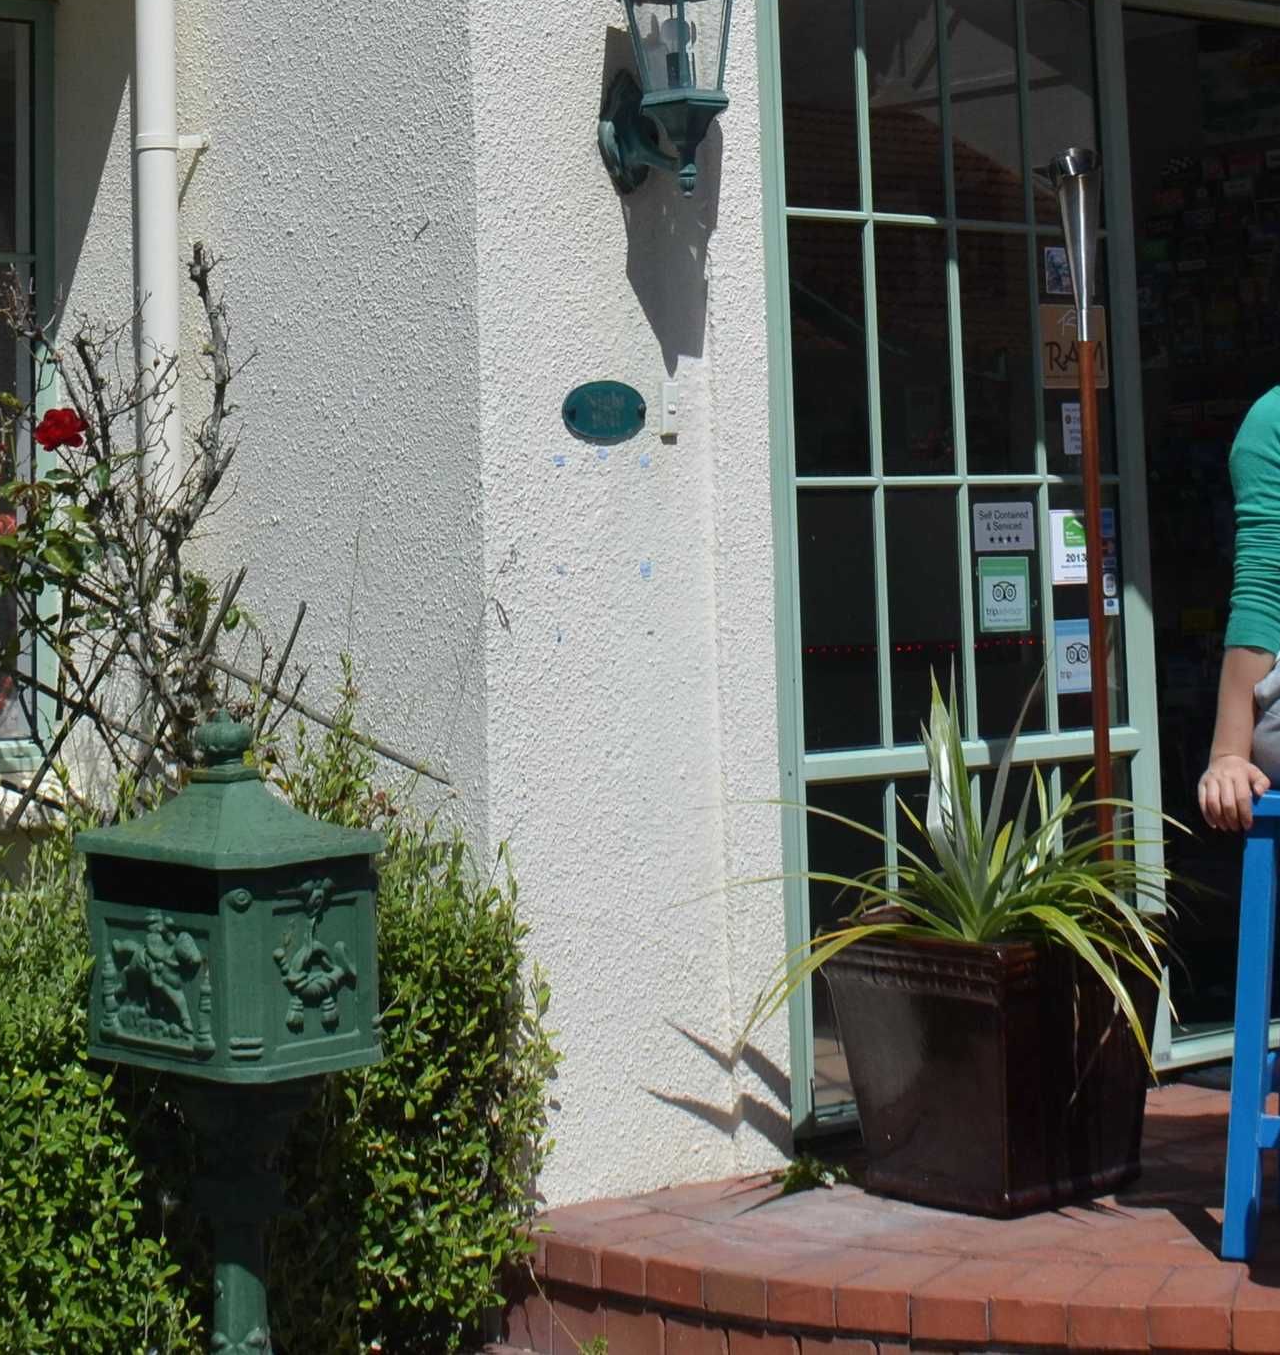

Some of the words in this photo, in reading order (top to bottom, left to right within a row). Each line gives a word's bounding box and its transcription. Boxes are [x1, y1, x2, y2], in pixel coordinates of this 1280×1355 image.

[978, 509, 993, 521] Self
[994, 509, 1029, 520] Contained
[993, 521, 1023, 532] Serviced
[1065, 553, 1087, 563] 2013
